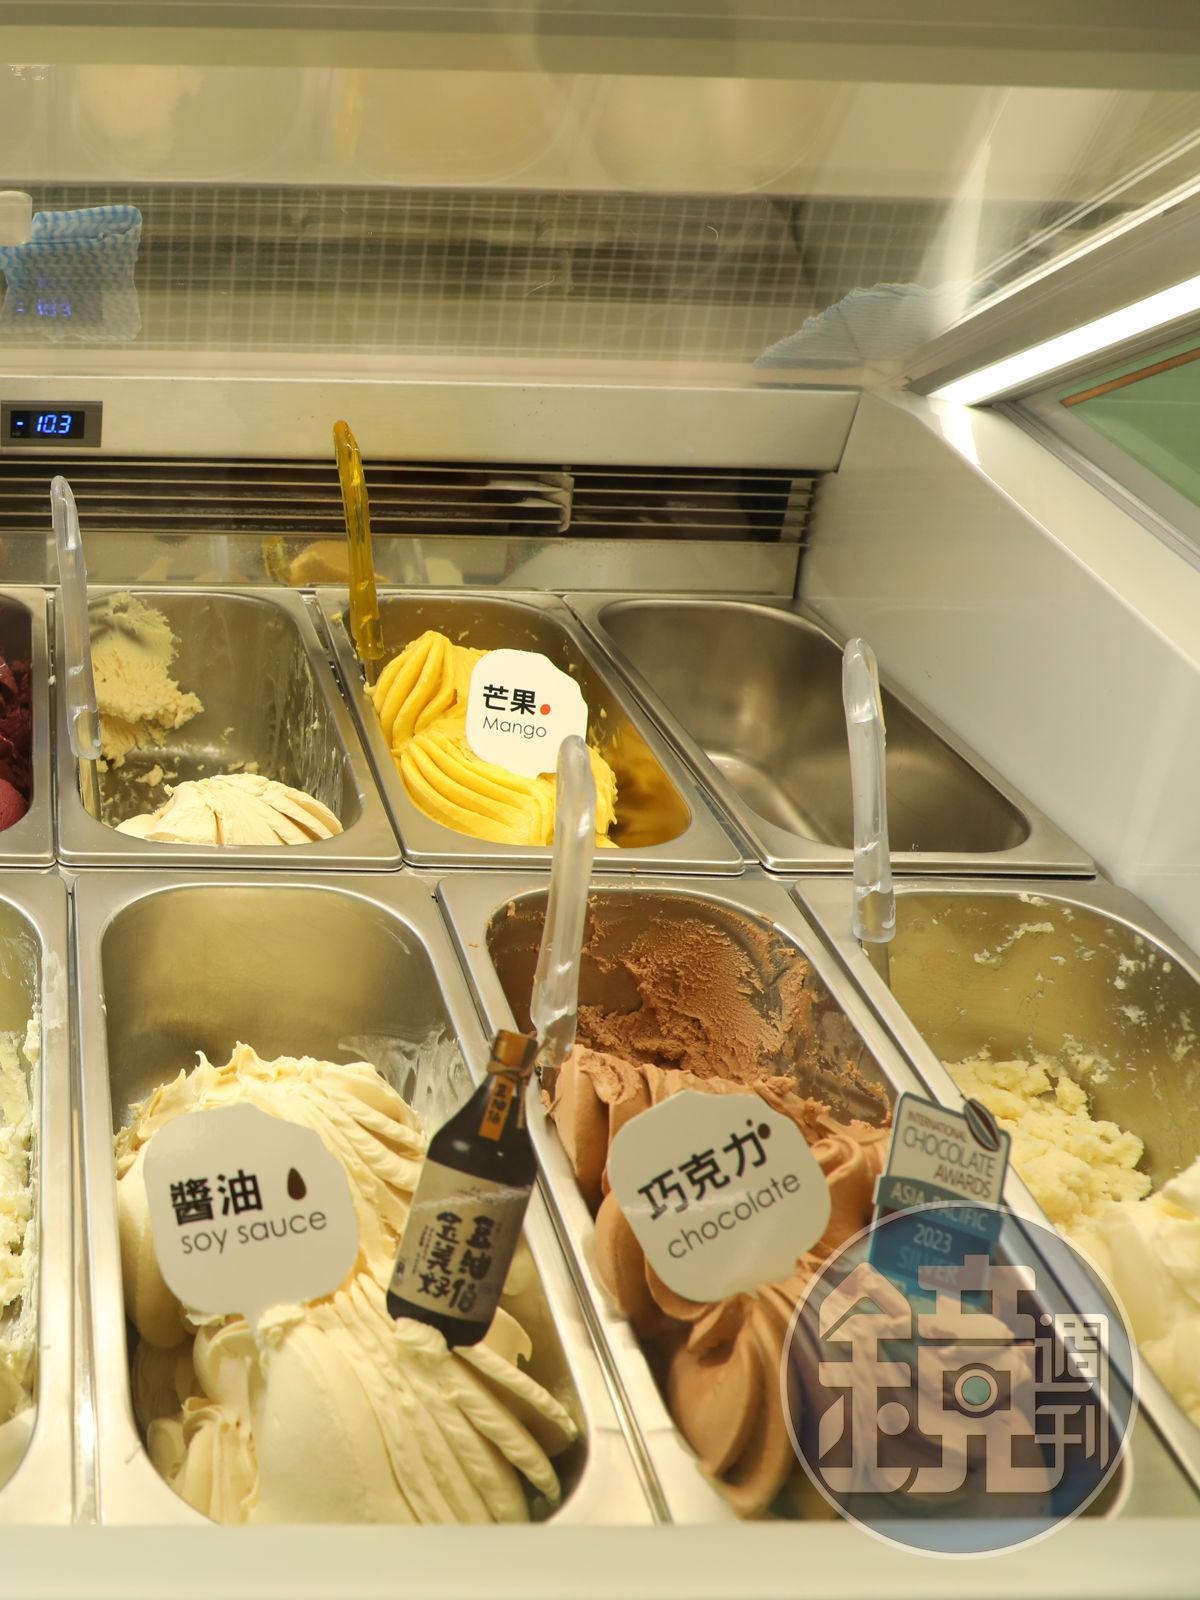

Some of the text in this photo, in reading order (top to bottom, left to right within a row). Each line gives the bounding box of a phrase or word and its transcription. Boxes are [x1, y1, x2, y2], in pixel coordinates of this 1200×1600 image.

[483, 684, 537, 715] 芒果
[482, 716, 547, 739] Mango
[637, 1125, 768, 1220] 巧克力
[902, 1126, 996, 1179] CHOCOLATE
[169, 1169, 263, 1227] 醬油
[933, 1164, 992, 1200] AWARDS
[181, 1206, 328, 1255] soy sauce
[667, 1170, 802, 1260] chocolate
[913, 1223, 953, 1254] 2023
